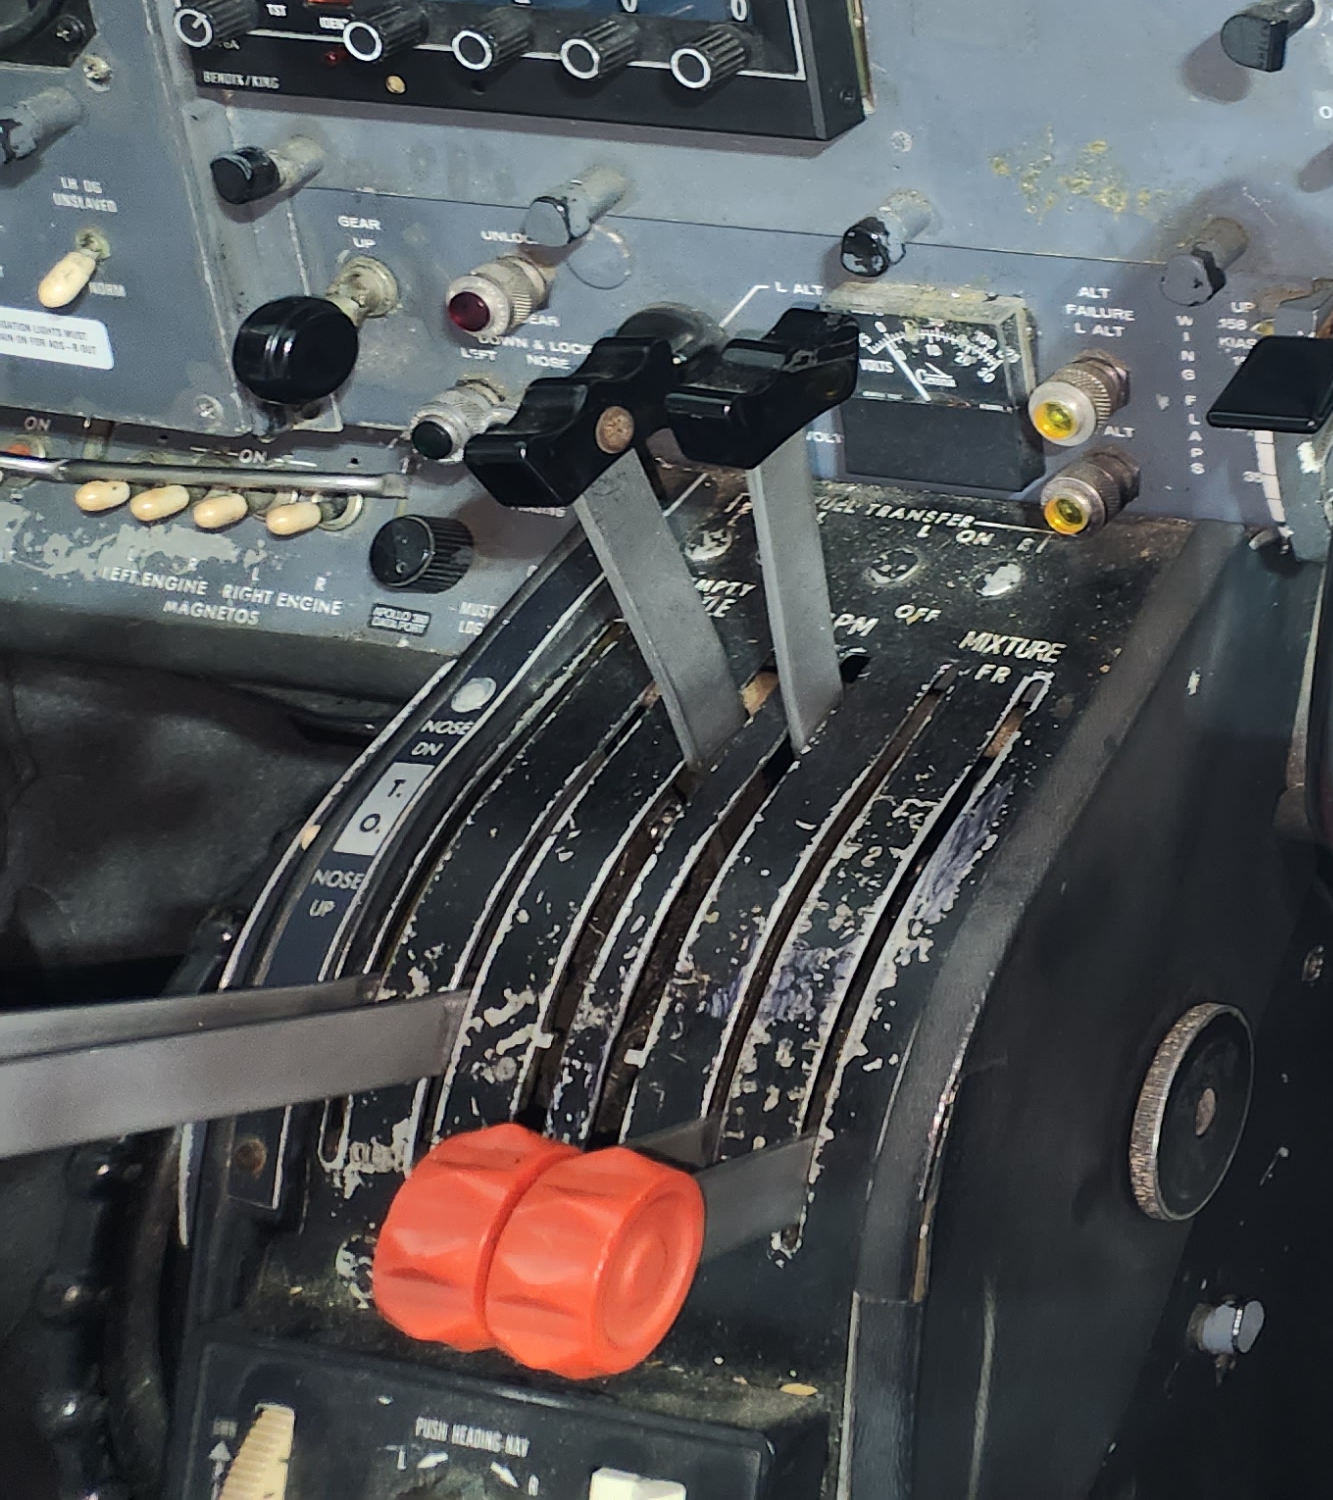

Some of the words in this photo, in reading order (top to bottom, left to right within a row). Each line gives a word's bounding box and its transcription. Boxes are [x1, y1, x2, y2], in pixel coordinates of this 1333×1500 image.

[338, 215, 381, 230] GEAR
[352, 237, 376, 248] UP
[1078, 287, 1110, 299] ALT
[1066, 305, 1136, 321] FAILURE
[1092, 325, 1125, 337] ALT
[526, 355, 570, 370] NOSE
[860, 359, 894, 373] VOLTS
[865, 504, 976, 528] TRANSFER
[956, 532, 995, 545] ON
[141, 572, 208, 595] ENGINE
[223, 585, 271, 606] RIGHT
[277, 591, 343, 615] ENGINE
[163, 599, 259, 625] MAGNETOS
[895, 605, 942, 623] OFF
[960, 631, 1066, 663] MIXTURE
[422, 720, 474, 734] NOSE
[312, 871, 364, 889] NOSE
[309, 900, 335, 917] UP
[415, 1418, 448, 1442] PUSH
[452, 1424, 502, 1452] HEADING
[504, 1436, 529, 1458] NAV
